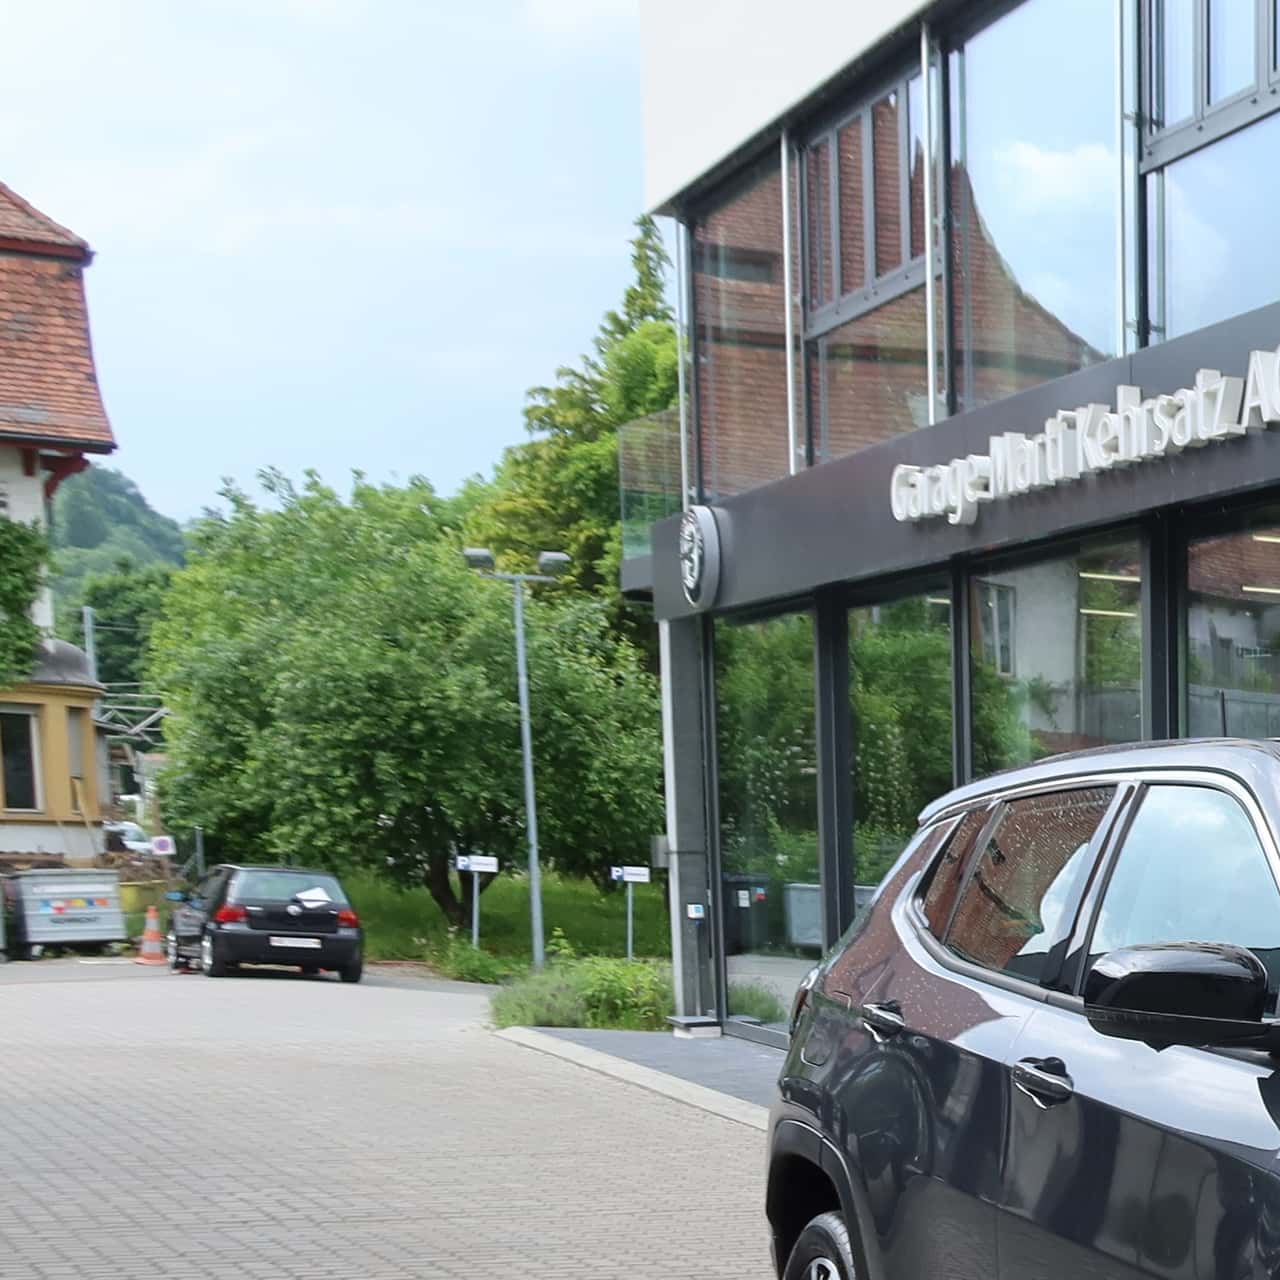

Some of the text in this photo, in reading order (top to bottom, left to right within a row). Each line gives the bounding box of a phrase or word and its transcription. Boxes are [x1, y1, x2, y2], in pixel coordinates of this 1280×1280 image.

[890, 455, 993, 526] Garage
[989, 409, 1080, 499] Marti
[1075, 368, 1246, 470] Kehrsatz
[610, 866, 623, 881] P
